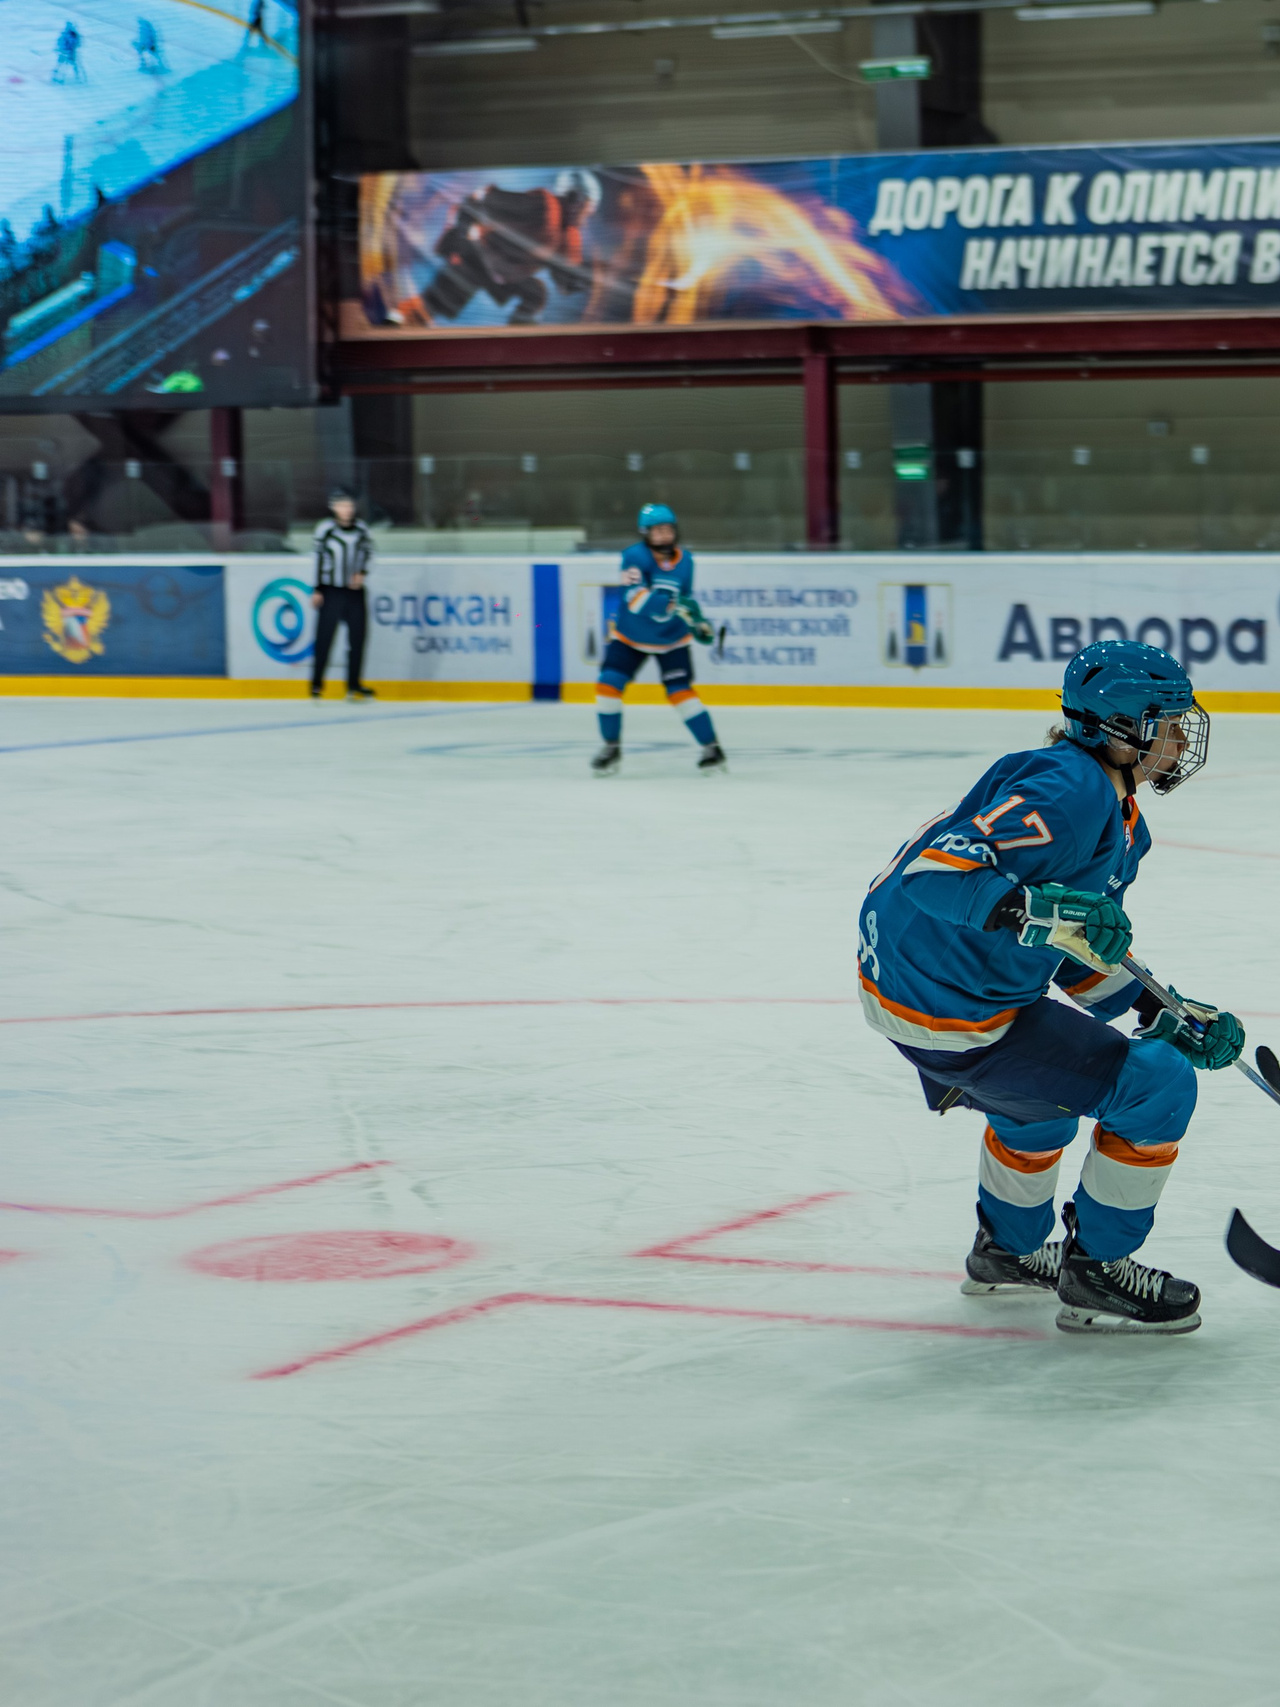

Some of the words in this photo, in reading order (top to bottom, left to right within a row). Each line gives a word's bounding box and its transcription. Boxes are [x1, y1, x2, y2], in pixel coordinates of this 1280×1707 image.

[868, 174, 1034, 236] ДОРОГА
[1043, 173, 1082, 226] К
[960, 231, 1242, 291] НАЧИНАЕТСЯ
[374, 593, 511, 632] едскан
[692, 586, 858, 609] АВИТЕЛЬСТВО
[1098, 722, 1129, 740] BAUER
[971, 794, 1054, 851] 17
